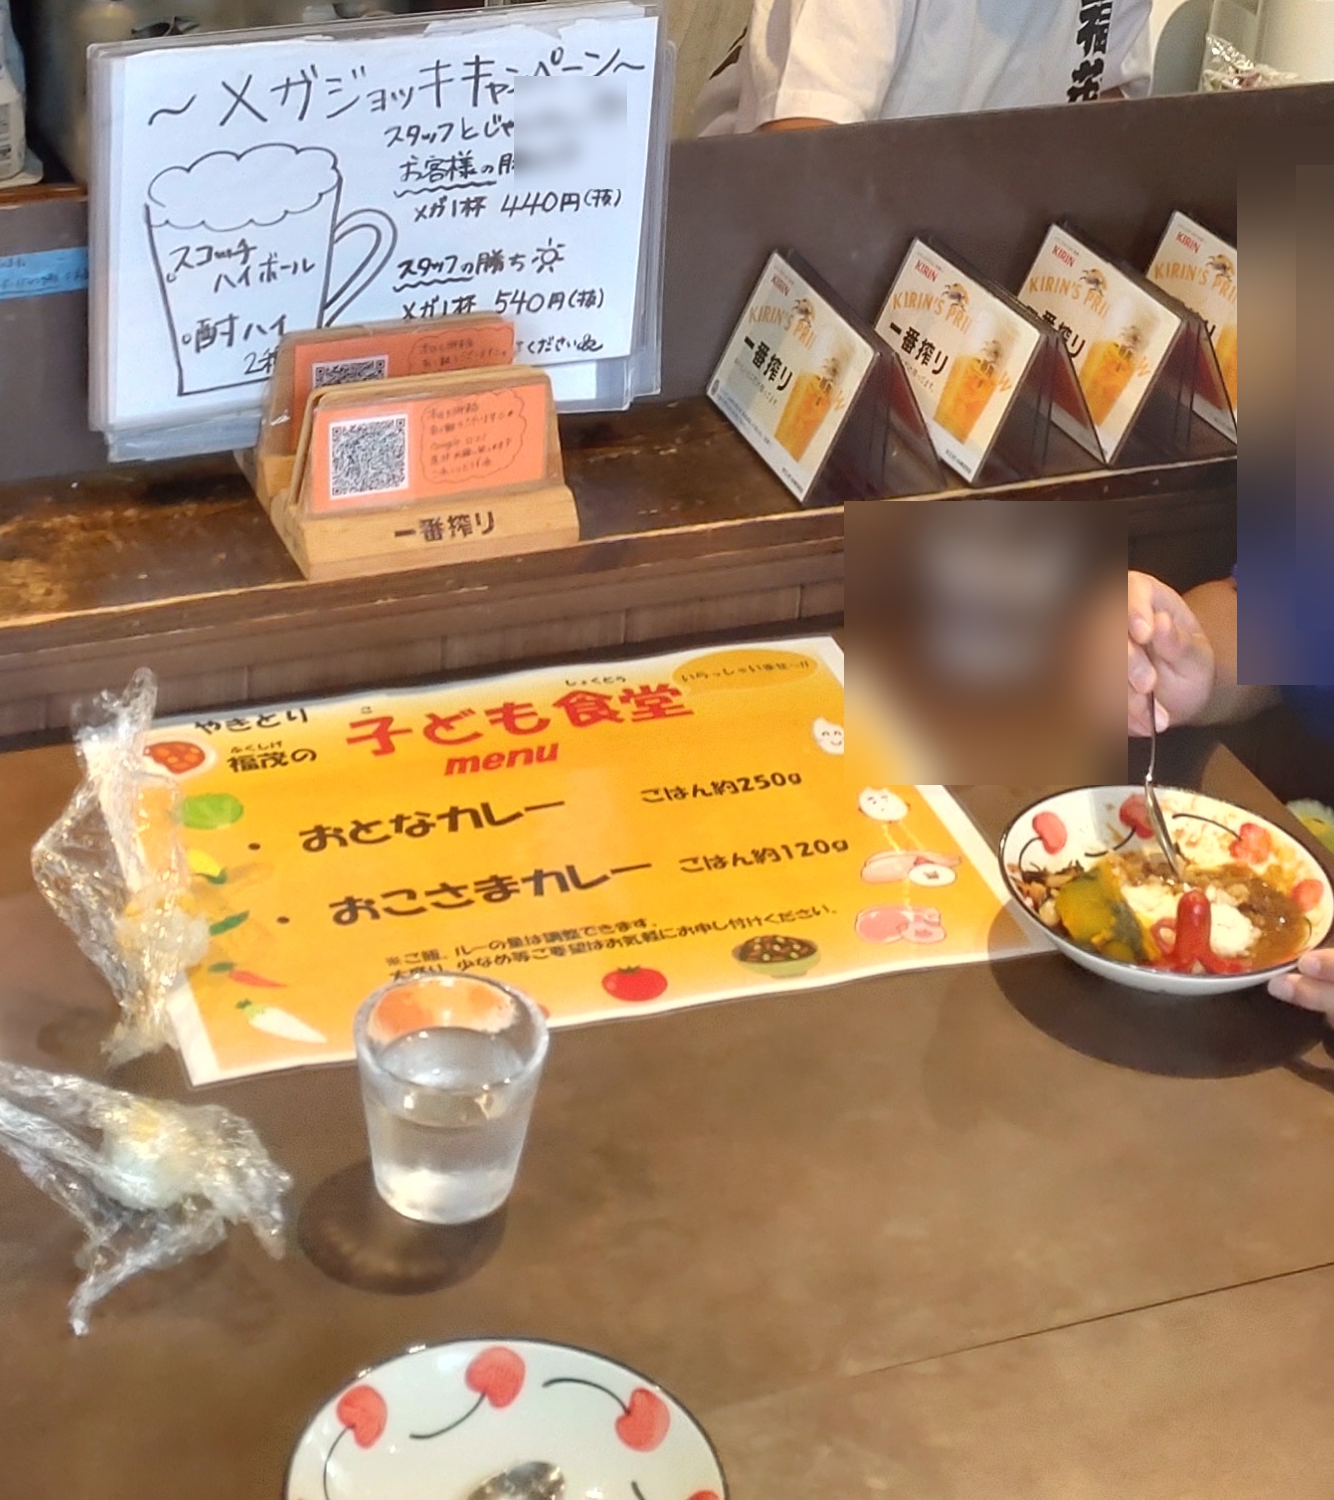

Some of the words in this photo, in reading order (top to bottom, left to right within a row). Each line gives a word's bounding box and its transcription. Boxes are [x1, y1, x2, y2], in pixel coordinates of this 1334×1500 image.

[1051, 244, 1077, 269] KIRIN
[1175, 230, 1202, 254] KIRIN
[770, 275, 792, 297] KIRIN
[914, 259, 939, 283] KIRIN
[743, 335, 793, 391] 一番搾り
[889, 321, 949, 376] 一番搾り
[393, 510, 495, 542] 一番搾り
[194, 707, 309, 736] やきとり
[345, 682, 695, 757] 子ども食堂
[226, 748, 317, 774] 福茂の
[443, 742, 560, 777] menu
[298, 799, 566, 853] おとなカレー
[639, 771, 803, 804] ごはん約250g
[328, 863, 652, 927] おこさまカレー
[677, 838, 850, 874] ごはん約120g
